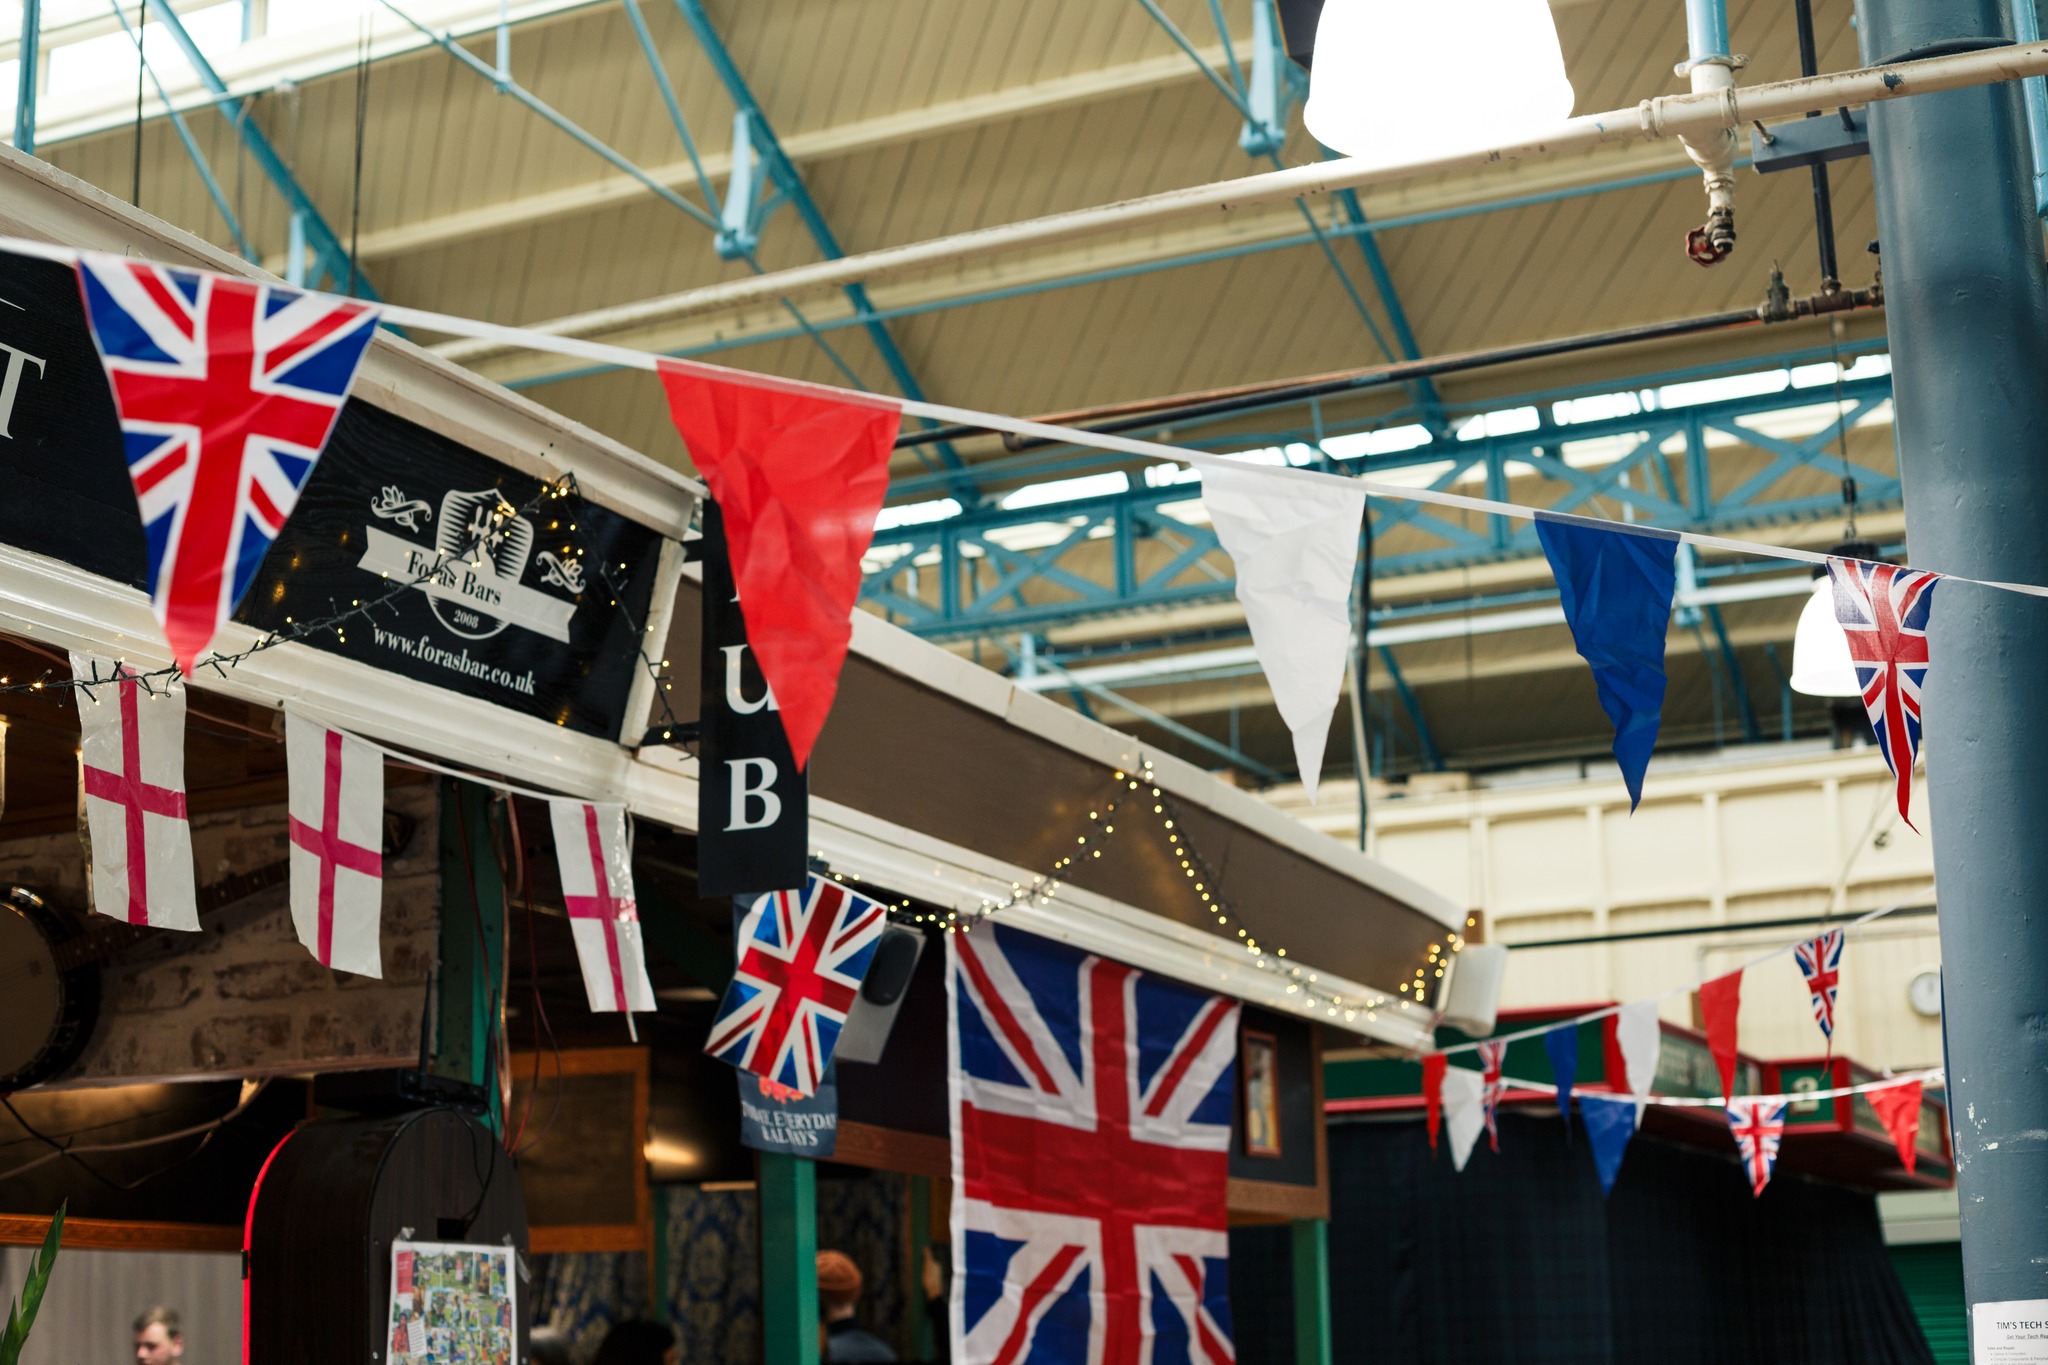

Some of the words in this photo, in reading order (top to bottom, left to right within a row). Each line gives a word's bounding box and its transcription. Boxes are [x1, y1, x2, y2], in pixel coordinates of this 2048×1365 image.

[461, 570, 502, 606] Bars
[453, 608, 480, 629] 2008
[373, 627, 536, 696] www.forasbar.co.uk
[718, 576, 783, 832] UB
[1996, 1321, 2017, 1330] TIM'S
[2019, 1321, 2042, 1329] TECH
